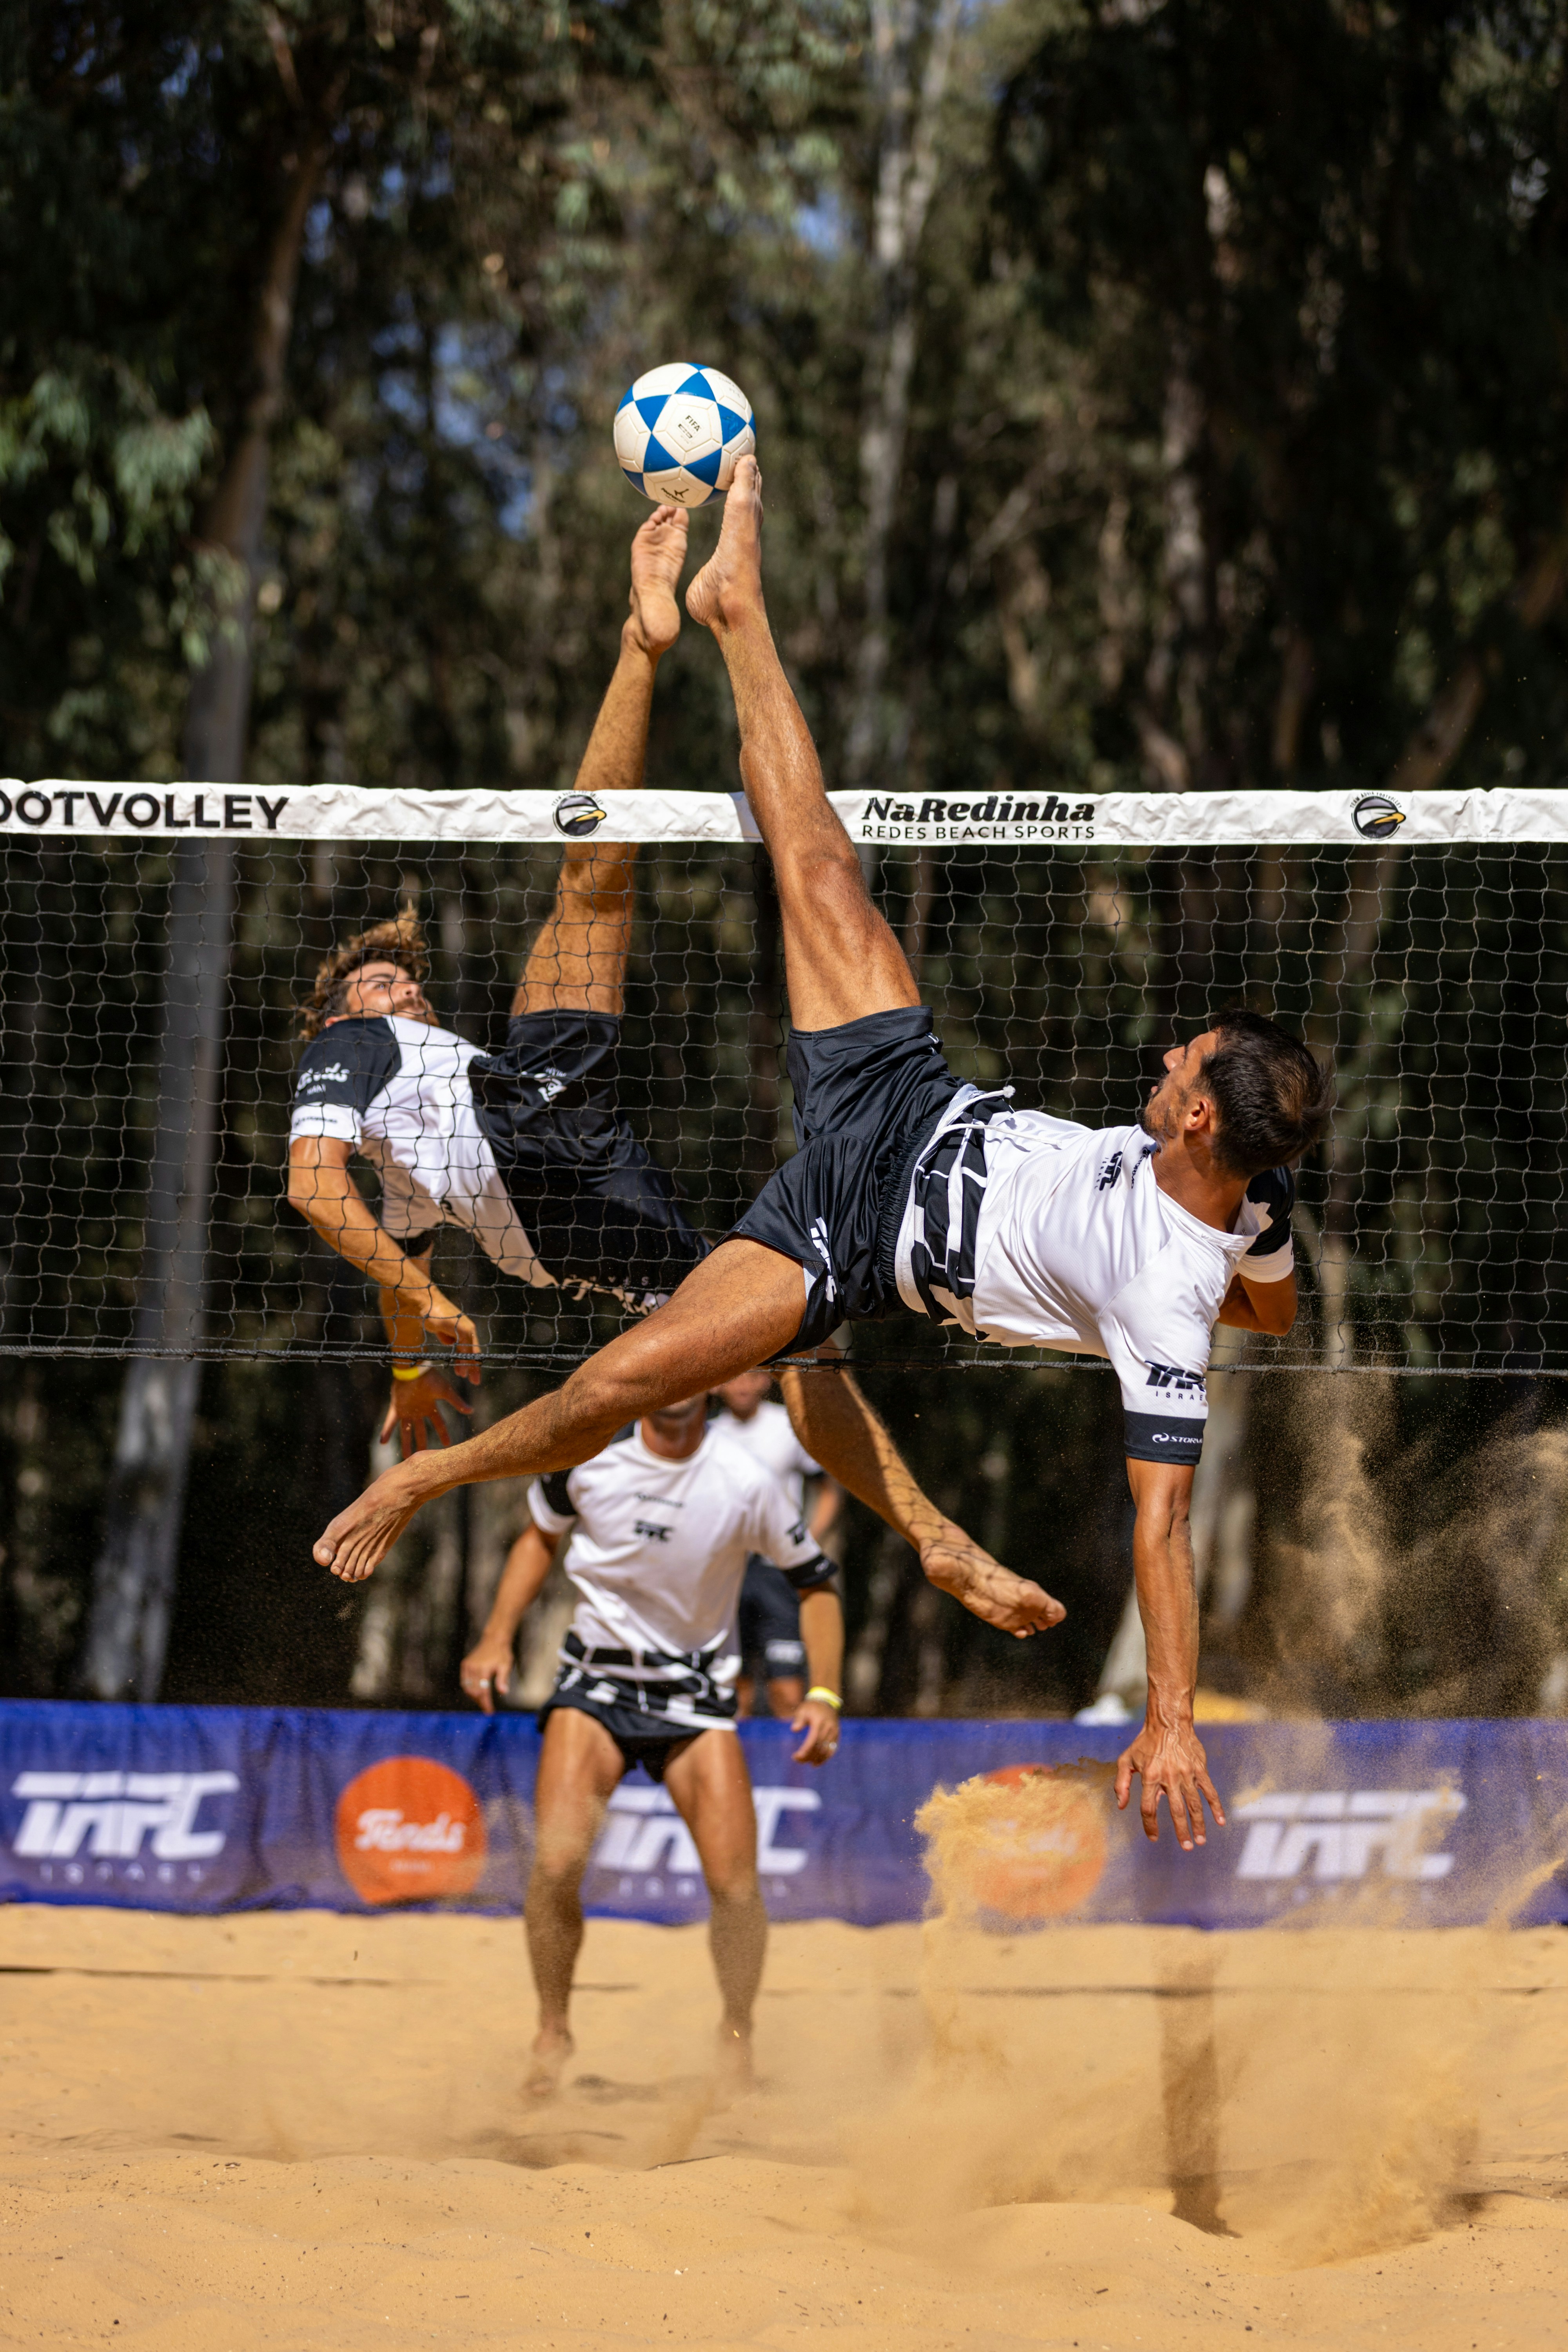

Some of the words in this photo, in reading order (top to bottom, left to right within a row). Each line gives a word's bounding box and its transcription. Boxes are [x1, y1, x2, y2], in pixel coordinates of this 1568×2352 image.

[685, 415, 700, 432] FIFA
[862, 795, 1095, 822] NaRedinha
[863, 825, 926, 839] REDES
[936, 826, 1006, 839] BEACH
[1014, 826, 1095, 839] SPORTS
[1156, 1391, 1203, 1401] ISRAE
